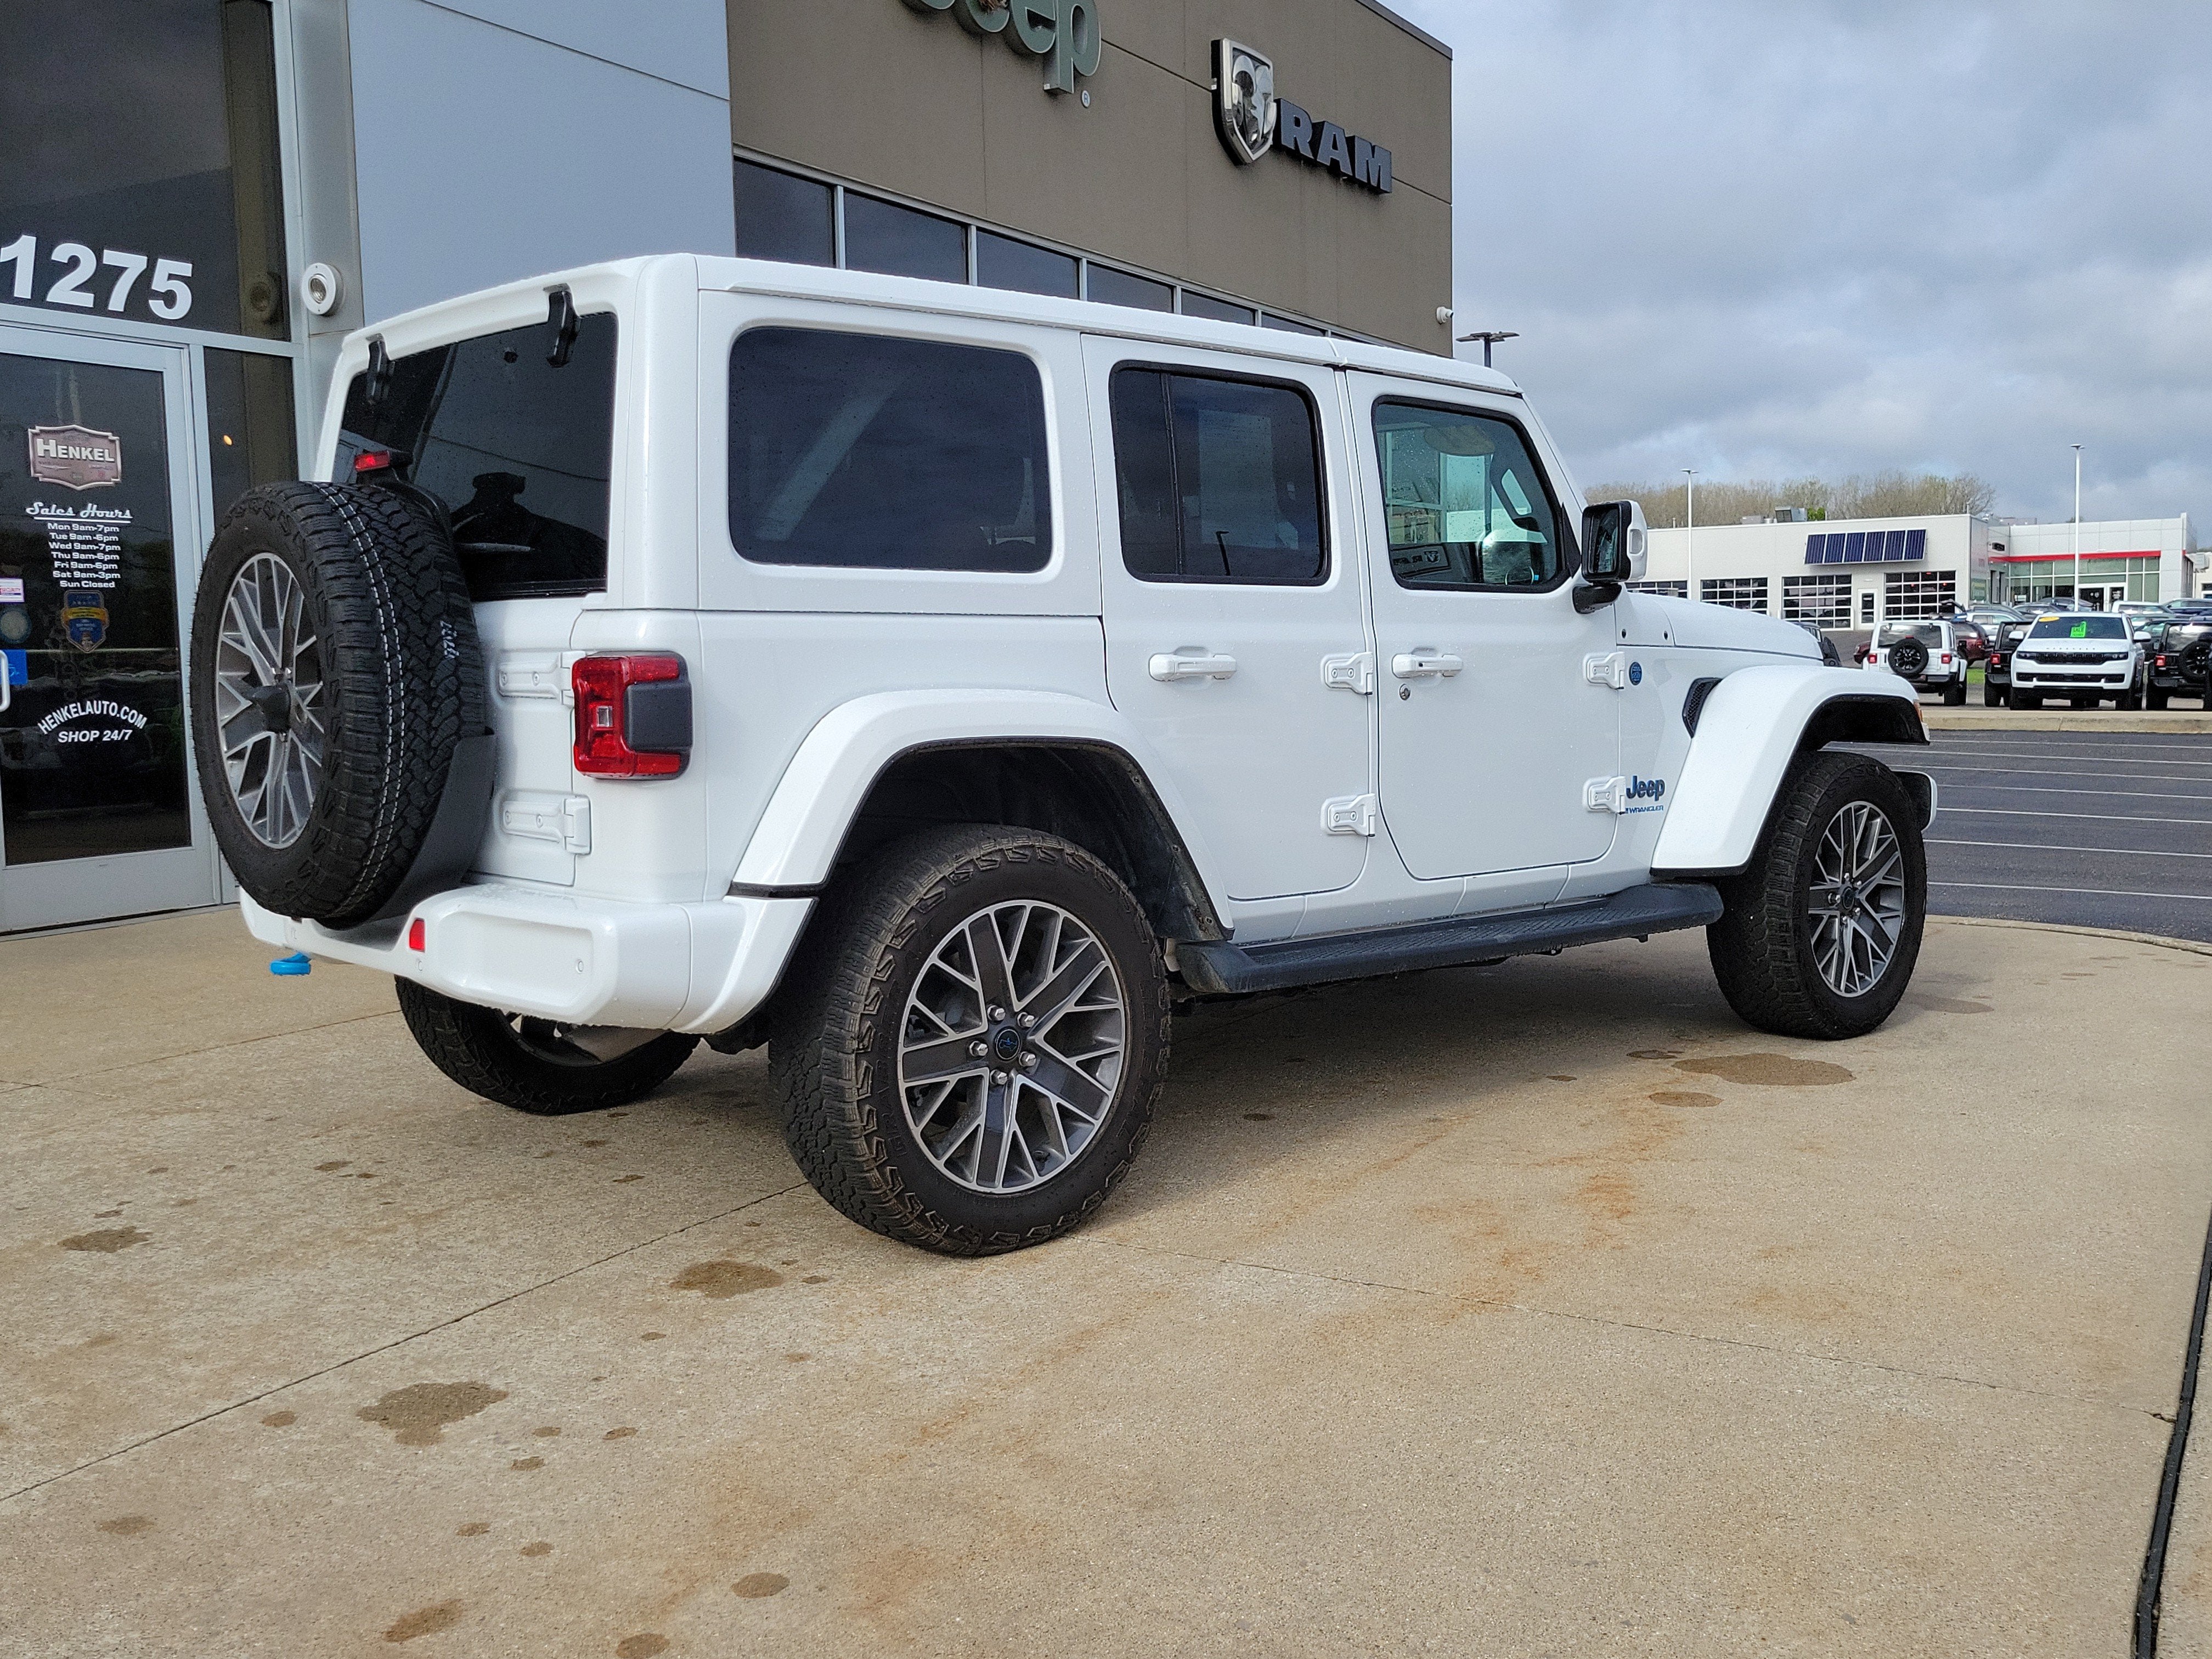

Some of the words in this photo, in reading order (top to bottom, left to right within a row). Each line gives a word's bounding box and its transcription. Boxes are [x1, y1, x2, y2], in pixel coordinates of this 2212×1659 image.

[1275, 98, 1392, 193] RAM
[0, 235, 193, 320] 1275
[36, 438, 115, 462] HENKEL
[26, 502, 76, 516] Sales
[80, 503, 133, 518] Hours
[72, 523, 120, 533] 9am-7pm
[74, 542, 121, 551] 9am-7pm
[72, 552, 120, 561] 9am-6pm
[70, 561, 118, 571] 9am-6pm
[73, 571, 121, 580] 9am-3pm
[37, 700, 148, 735] HENKELAUTO.COM
[58, 730, 100, 743] SHOP
[102, 729, 133, 741] 24/7
[1626, 775, 1665, 802] Jeep
[1629, 805, 1664, 814] WRANGLER
